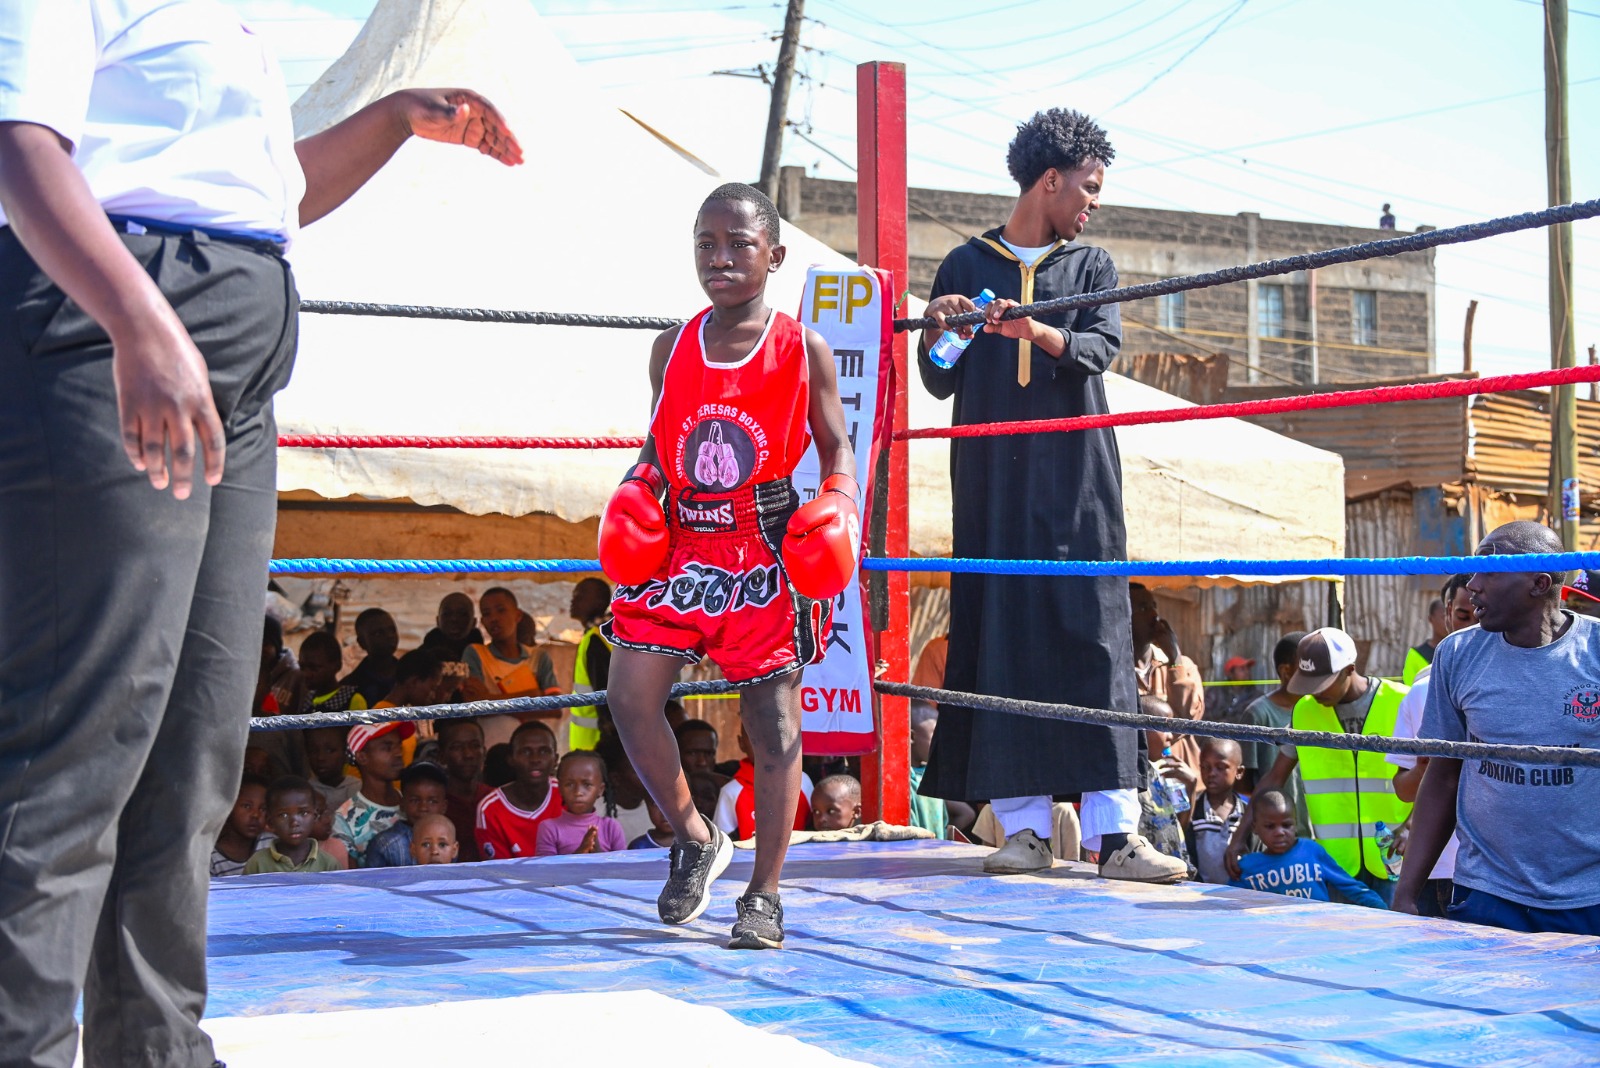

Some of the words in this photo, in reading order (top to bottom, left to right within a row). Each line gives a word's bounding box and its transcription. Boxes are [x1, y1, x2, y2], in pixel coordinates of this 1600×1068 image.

[682, 416, 697, 431] ST.
[738, 412, 768, 447] BOXING
[678, 501, 734, 524] TWINS
[801, 687, 861, 713] GYM
[1478, 760, 1525, 785] BOXING
[1530, 767, 1574, 786] CLUB
[1245, 863, 1323, 891] TROUBLE
